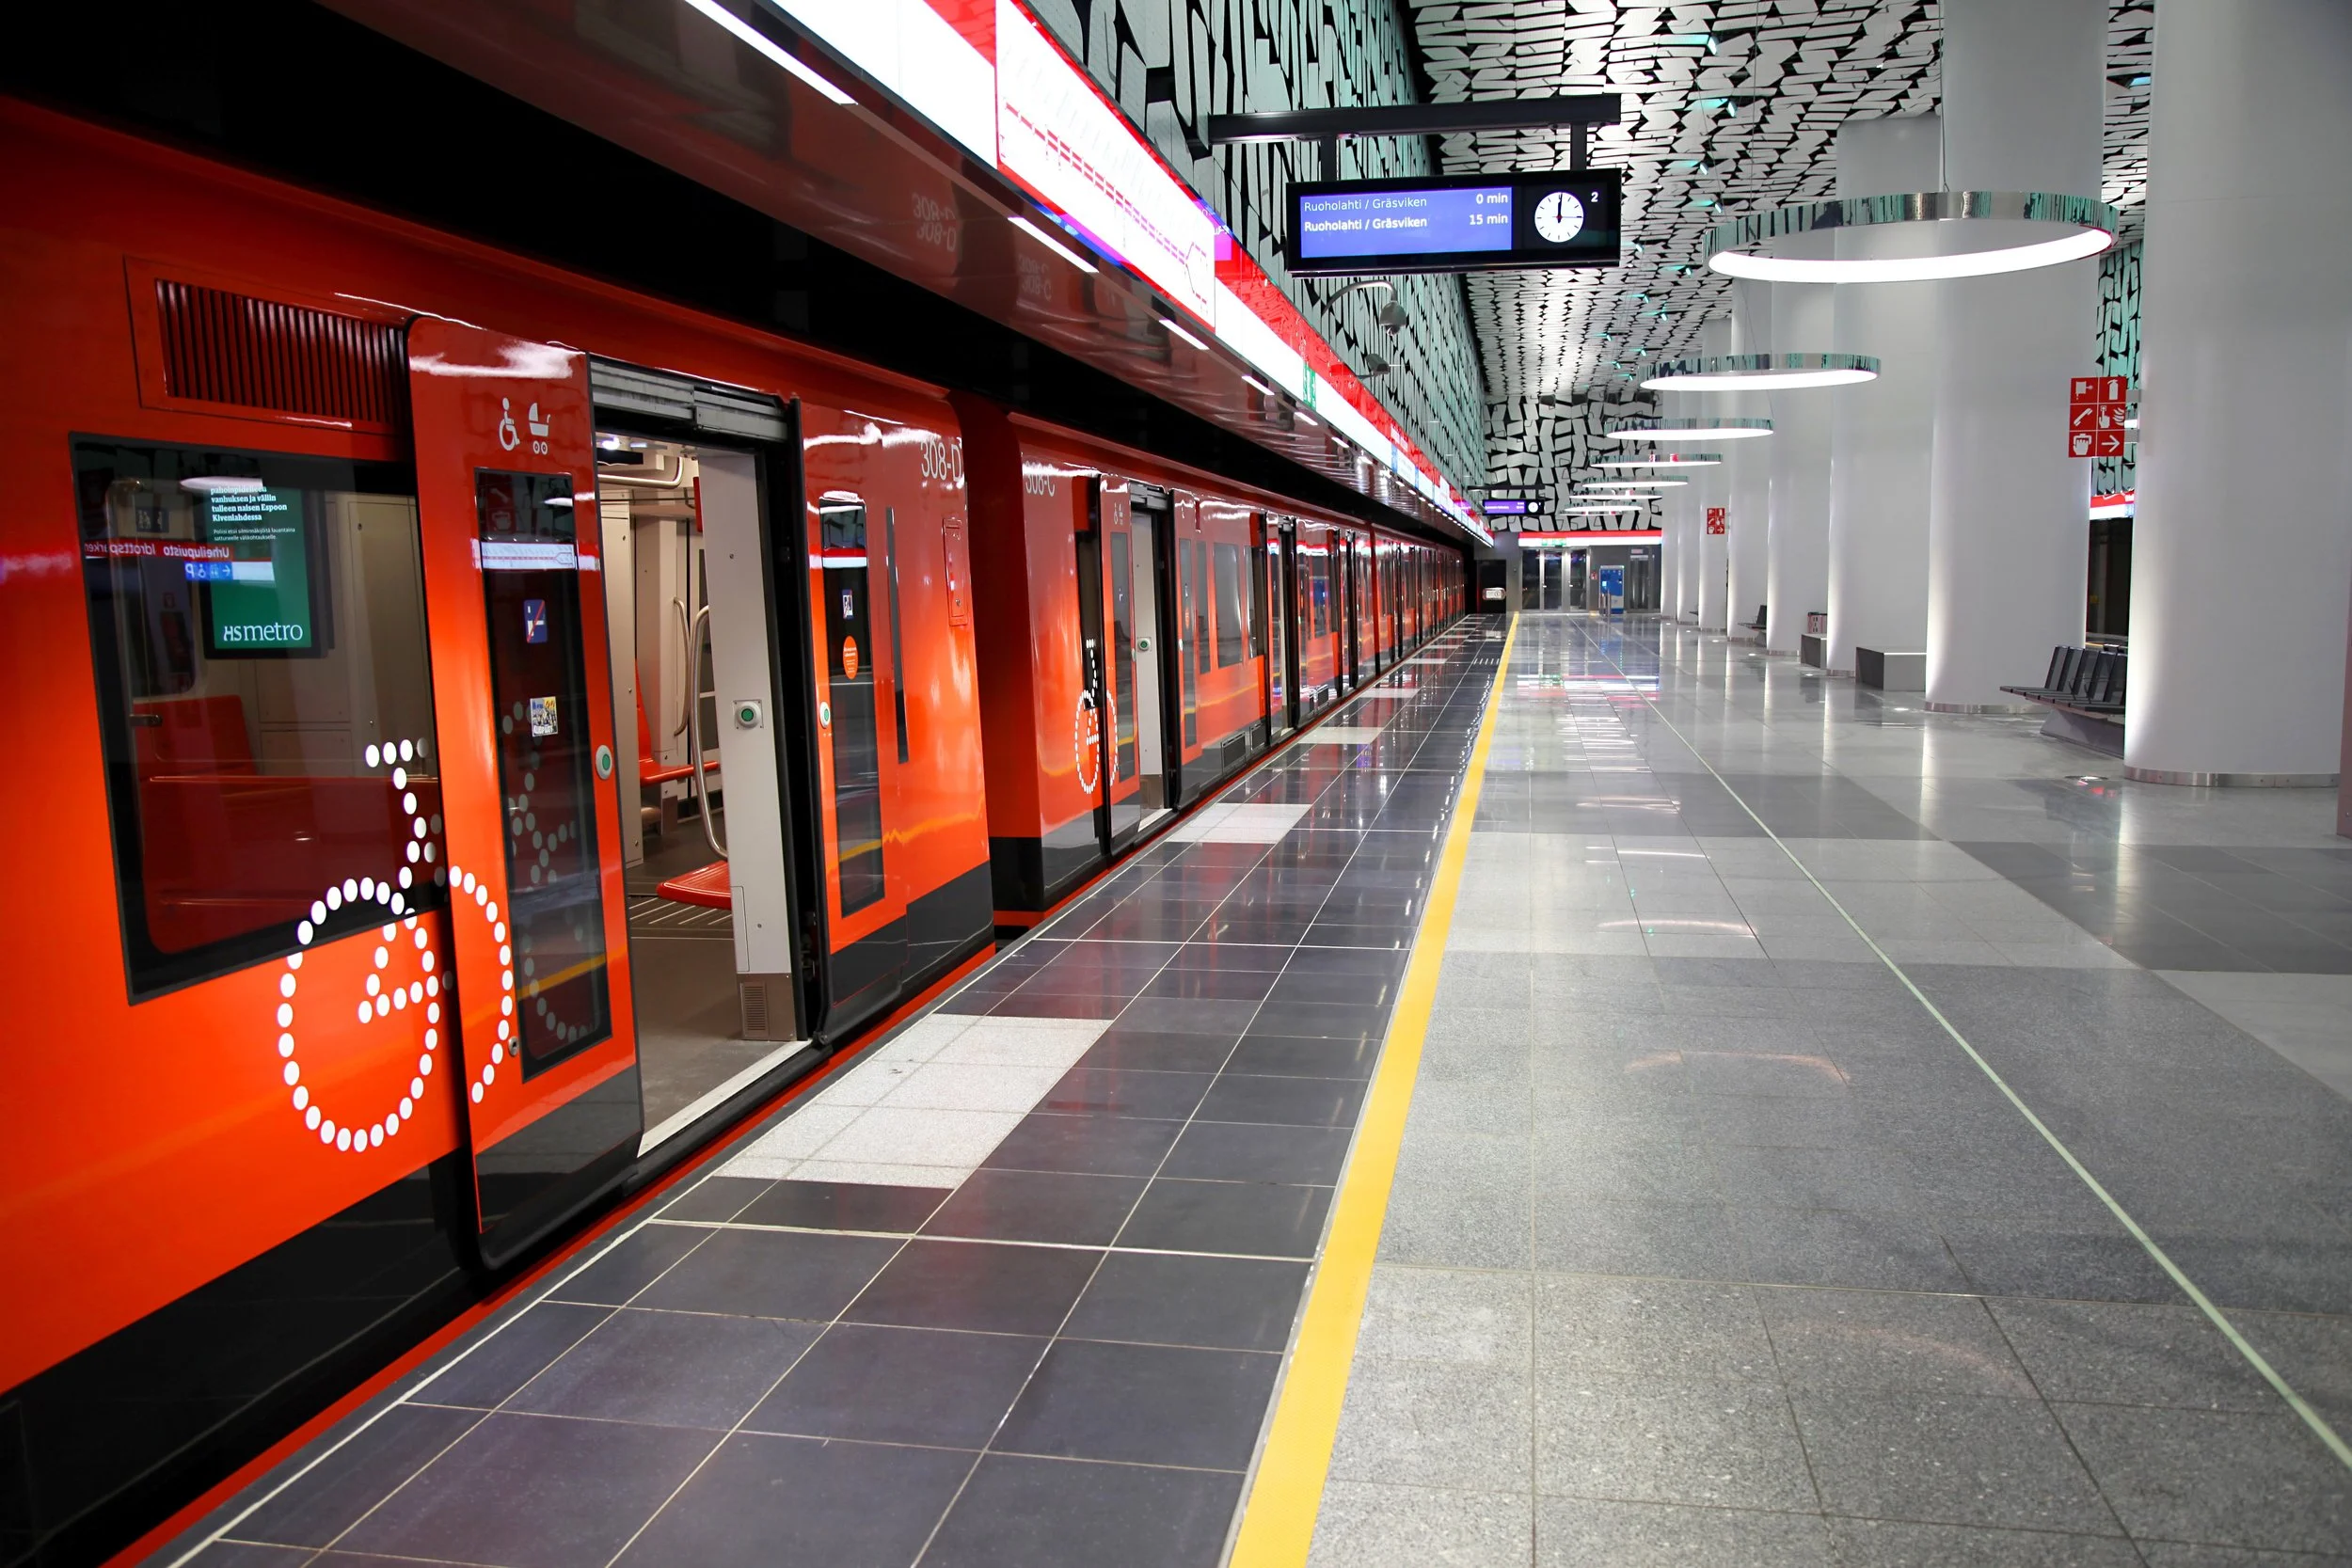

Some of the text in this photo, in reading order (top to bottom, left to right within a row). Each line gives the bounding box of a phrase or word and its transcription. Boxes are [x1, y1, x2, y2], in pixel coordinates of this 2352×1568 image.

[1475, 193, 1508, 205] 0 min
[1591, 192, 1598, 203] 2
[1304, 199, 1362, 212] Ruoholahti
[1372, 197, 1427, 209] Gräsviken
[1304, 219, 1362, 232] Ruoholahti
[1372, 217, 1427, 230] Gräsviken
[1470, 213, 1508, 226] 15 min
[921, 438, 962, 483] 308-D
[248, 496, 256, 504] ja
[257, 494, 277, 502] väliin
[261, 503, 288, 513] Espoon
[213, 514, 262, 522] Kivenlahdessa
